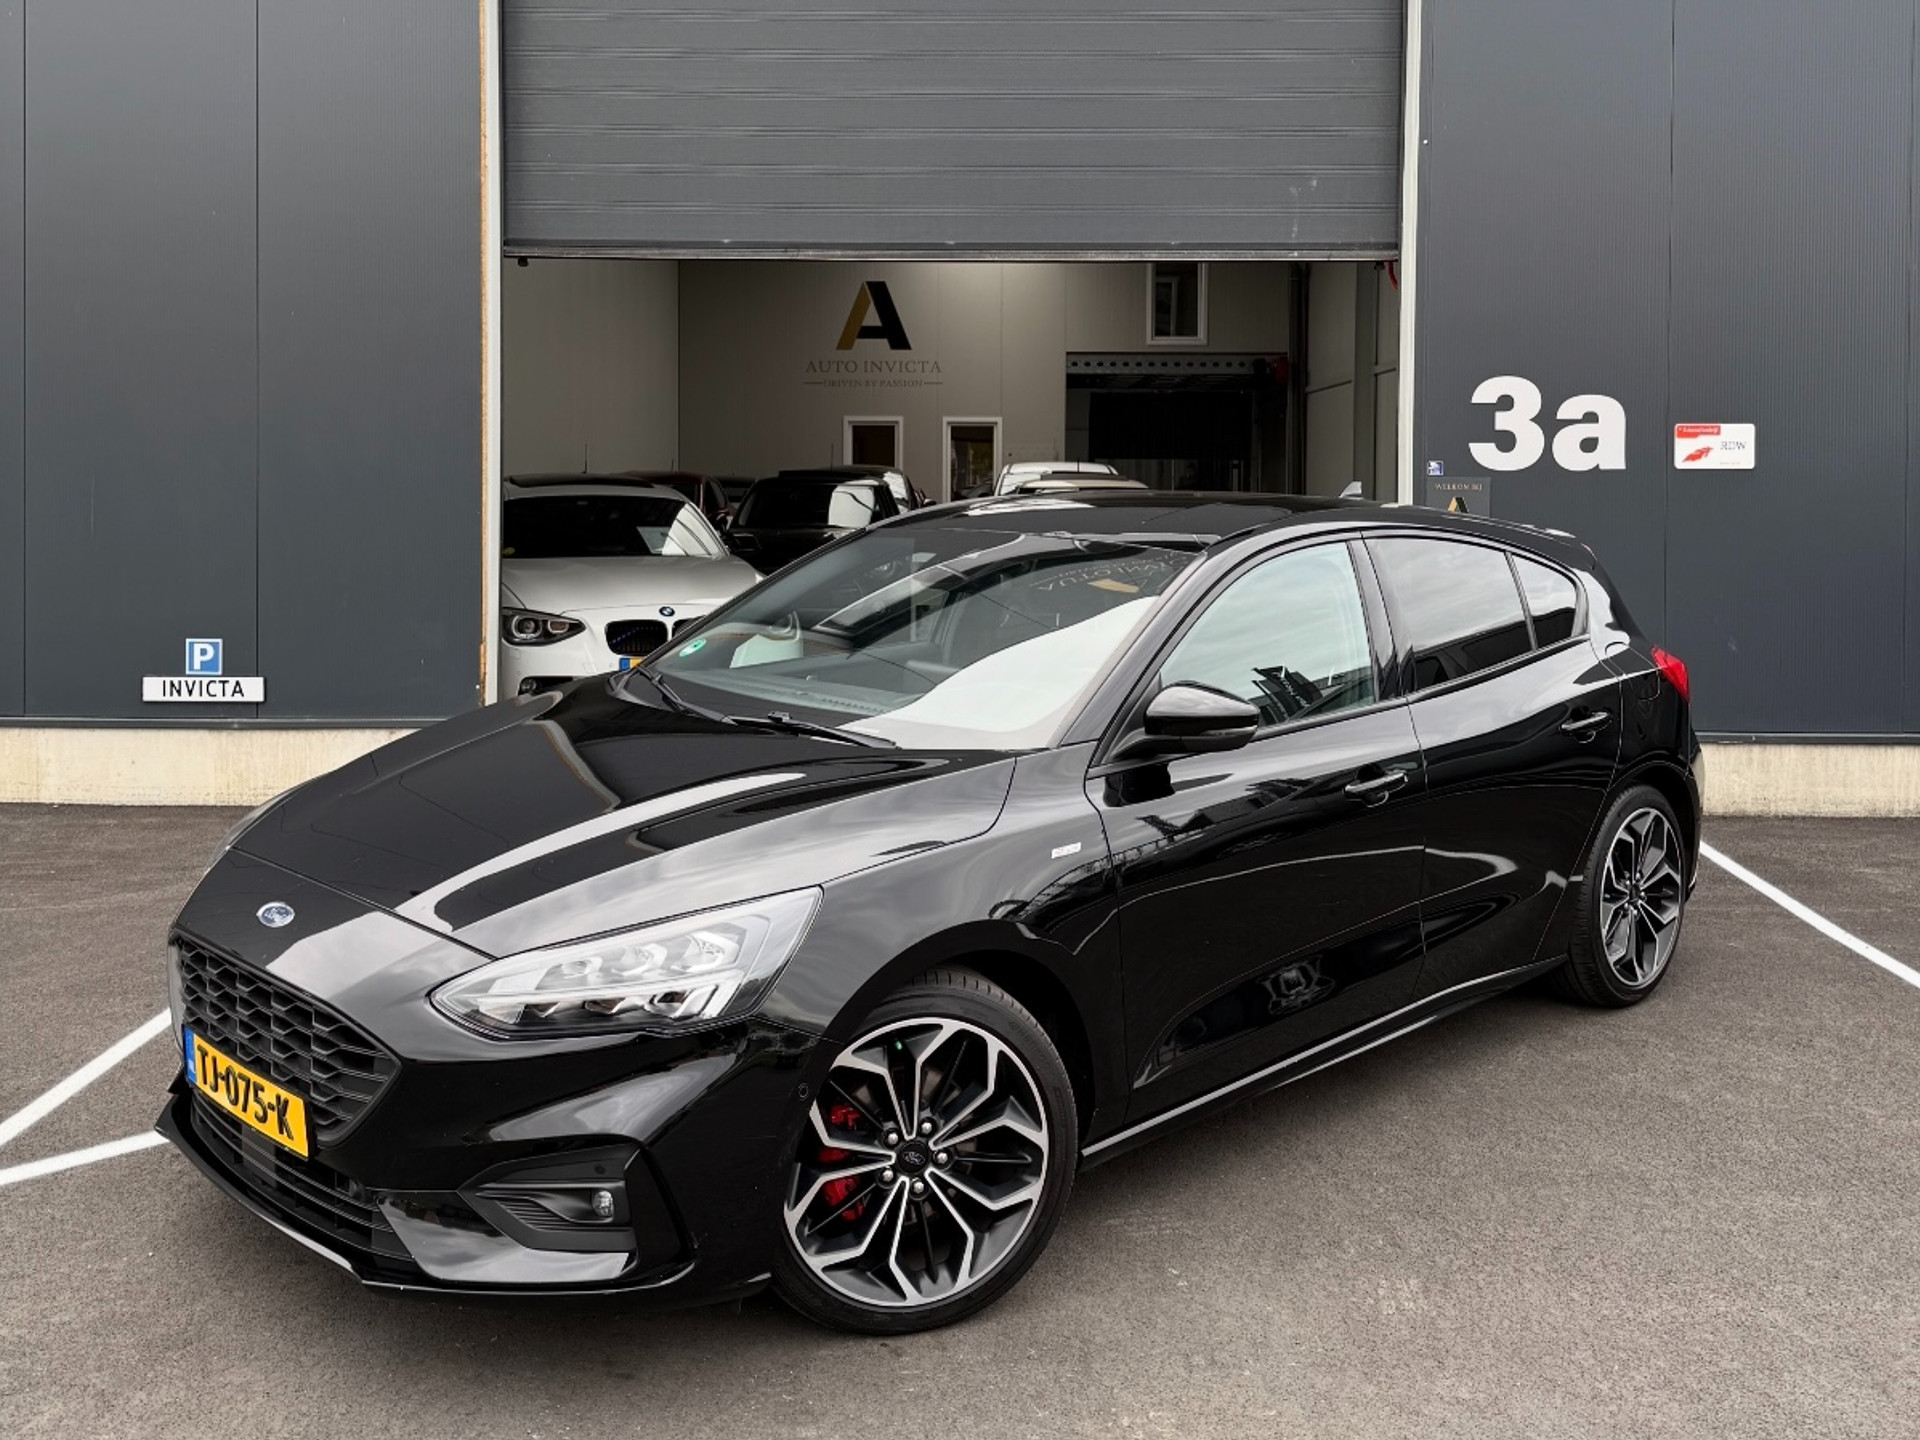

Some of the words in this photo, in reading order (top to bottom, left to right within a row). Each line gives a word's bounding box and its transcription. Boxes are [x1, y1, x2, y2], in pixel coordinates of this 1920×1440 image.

[836, 281, 912, 351] A
[805, 360, 859, 374] AUTO
[863, 360, 942, 374] INVICTA
[823, 379, 862, 388] DRIVEN
[864, 379, 878, 388] BY
[879, 379, 923, 388] PASSION
[1468, 375, 1627, 472] 3a
[193, 642, 215, 670] P
[162, 679, 245, 697] INVICTA
[197, 1043, 294, 1141] TJ-075-K
